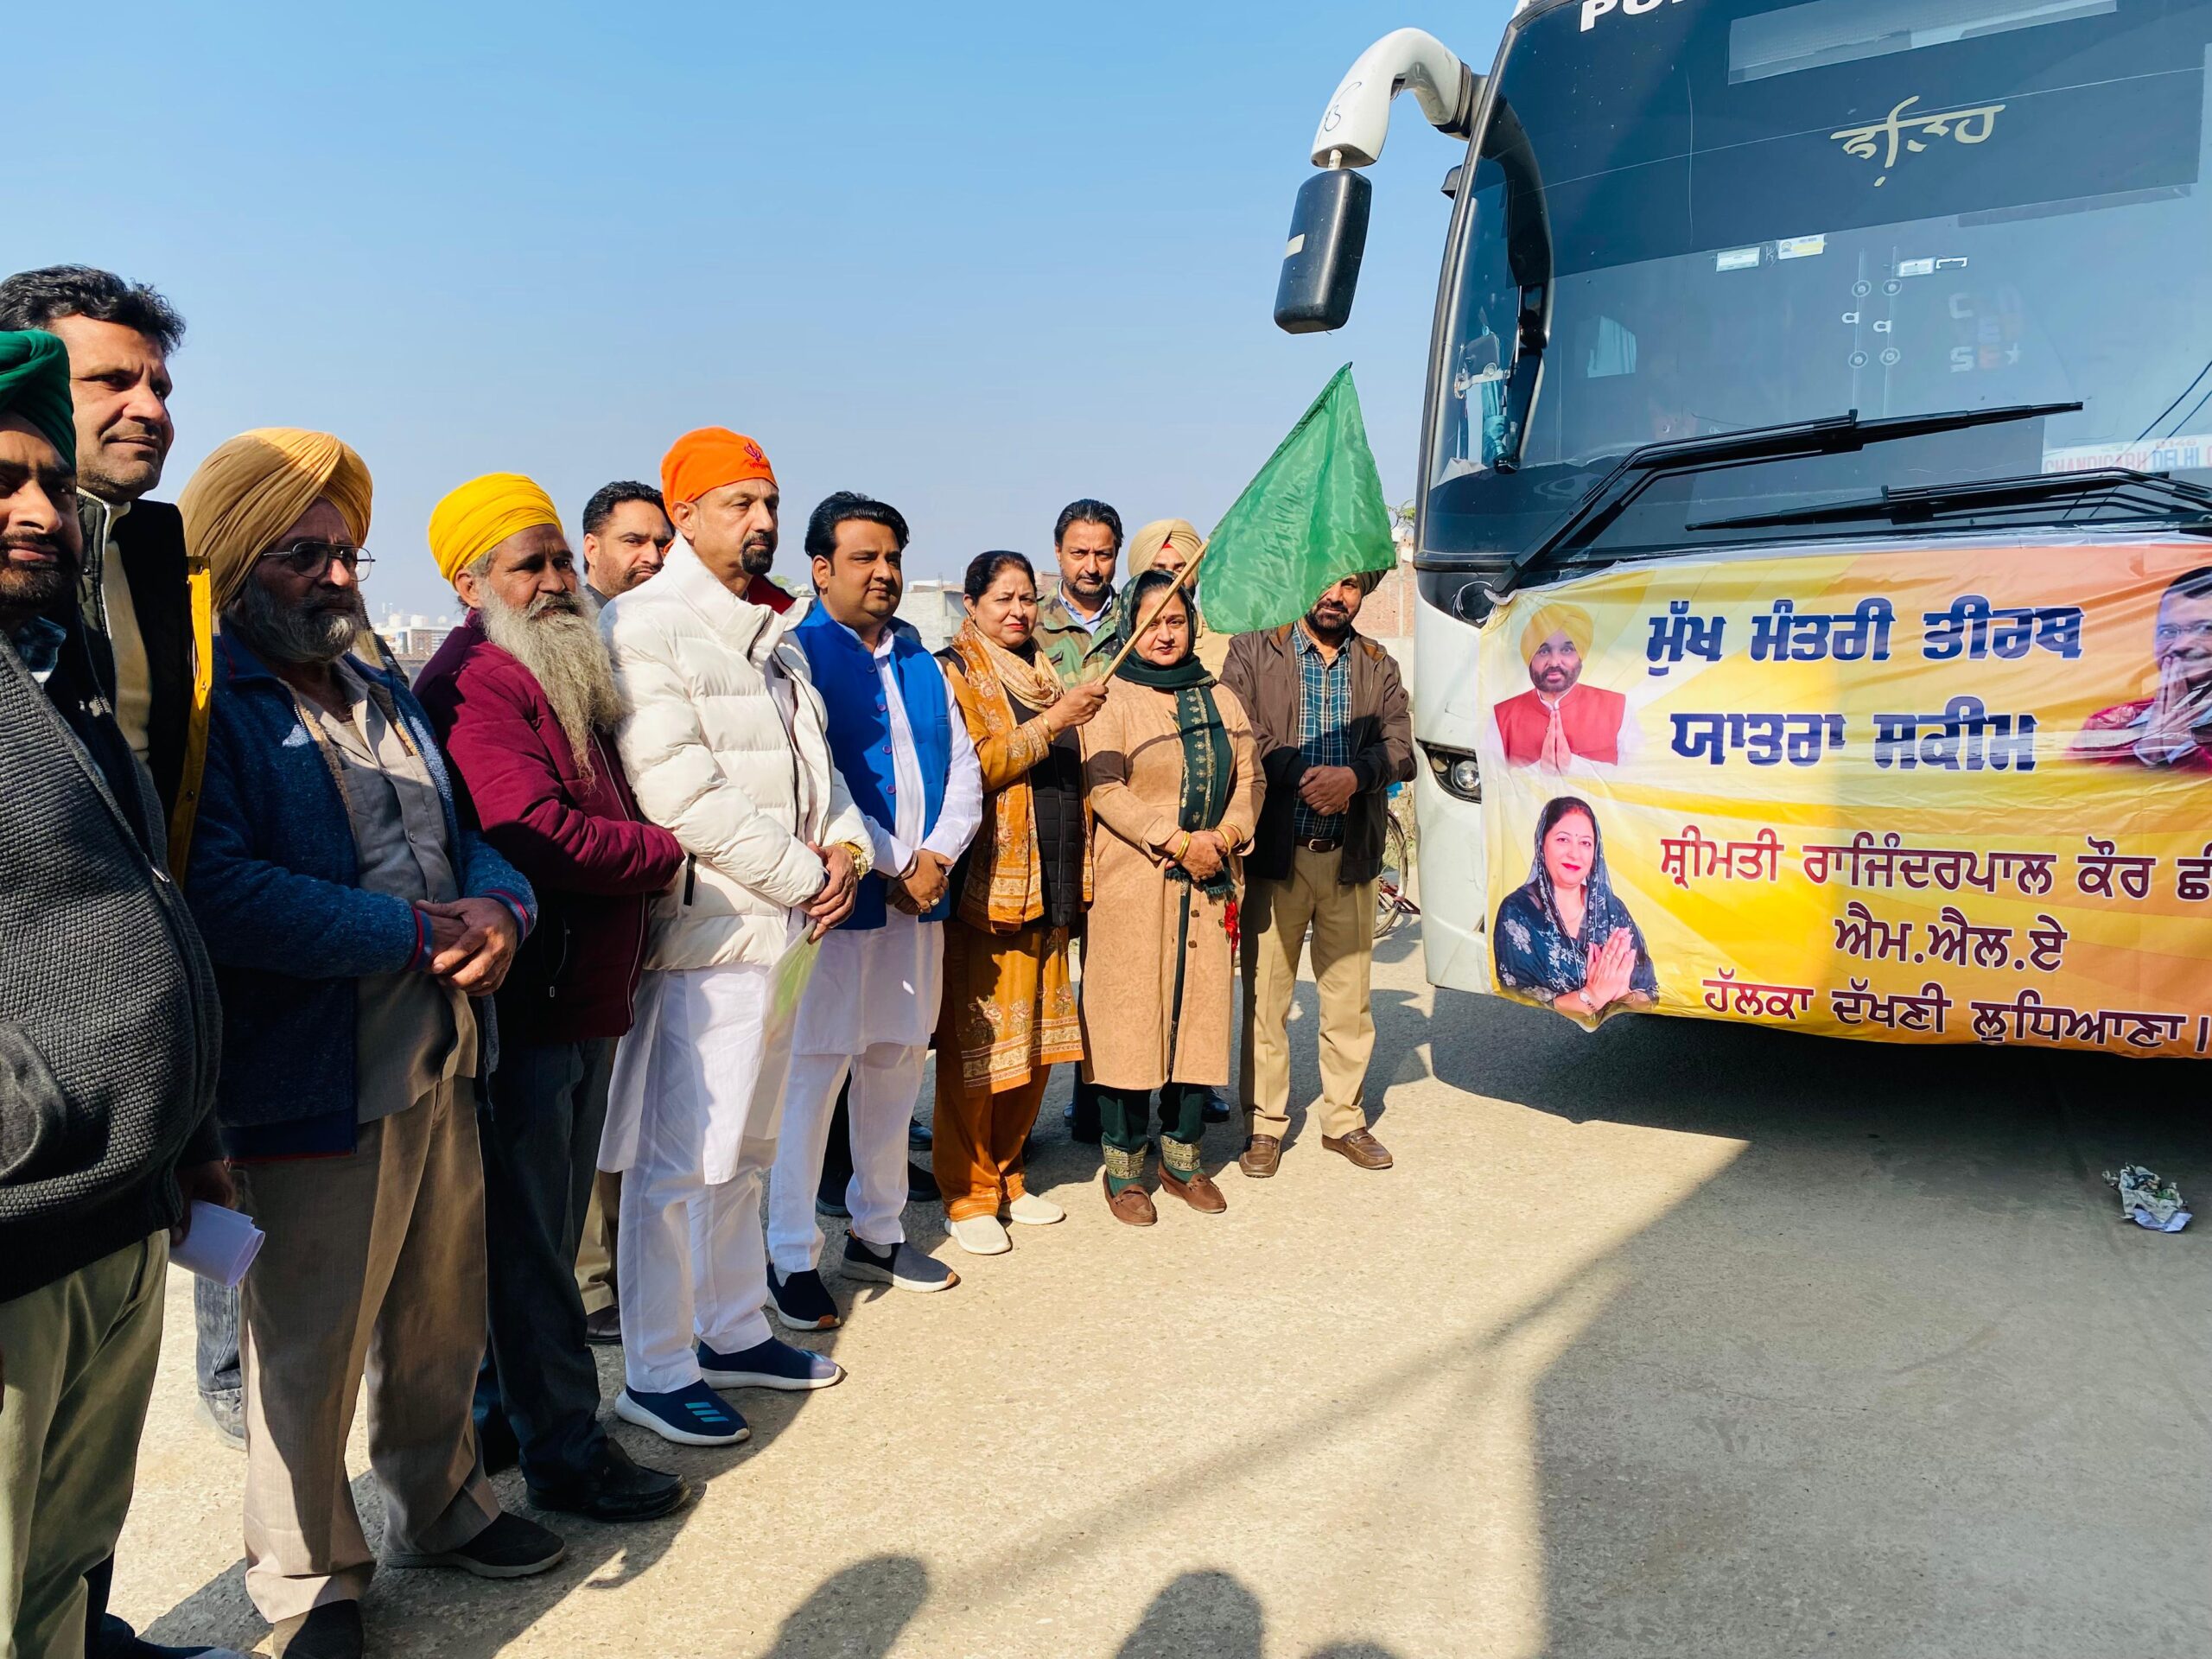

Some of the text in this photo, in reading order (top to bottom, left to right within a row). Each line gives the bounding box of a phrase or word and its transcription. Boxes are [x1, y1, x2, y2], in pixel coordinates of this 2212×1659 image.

[2153, 447, 2200, 470] DELHI
[1646, 594, 2084, 677] ਮੁੱਖ ਮੰਤਰੀ ਤੀਰਥ
[1670, 696, 2038, 771] ਯਾਤਰਾ ਸਕੀਮ
[1802, 831, 2057, 895] ਰਾਜਿੰਦਰਪਾਲ
[2077, 836, 2157, 899] ਕੌਰ
[1702, 967, 1815, 1020] ਹੱਲਕਾ
[1832, 977, 1952, 1030] ਦੱਖਣੀ
